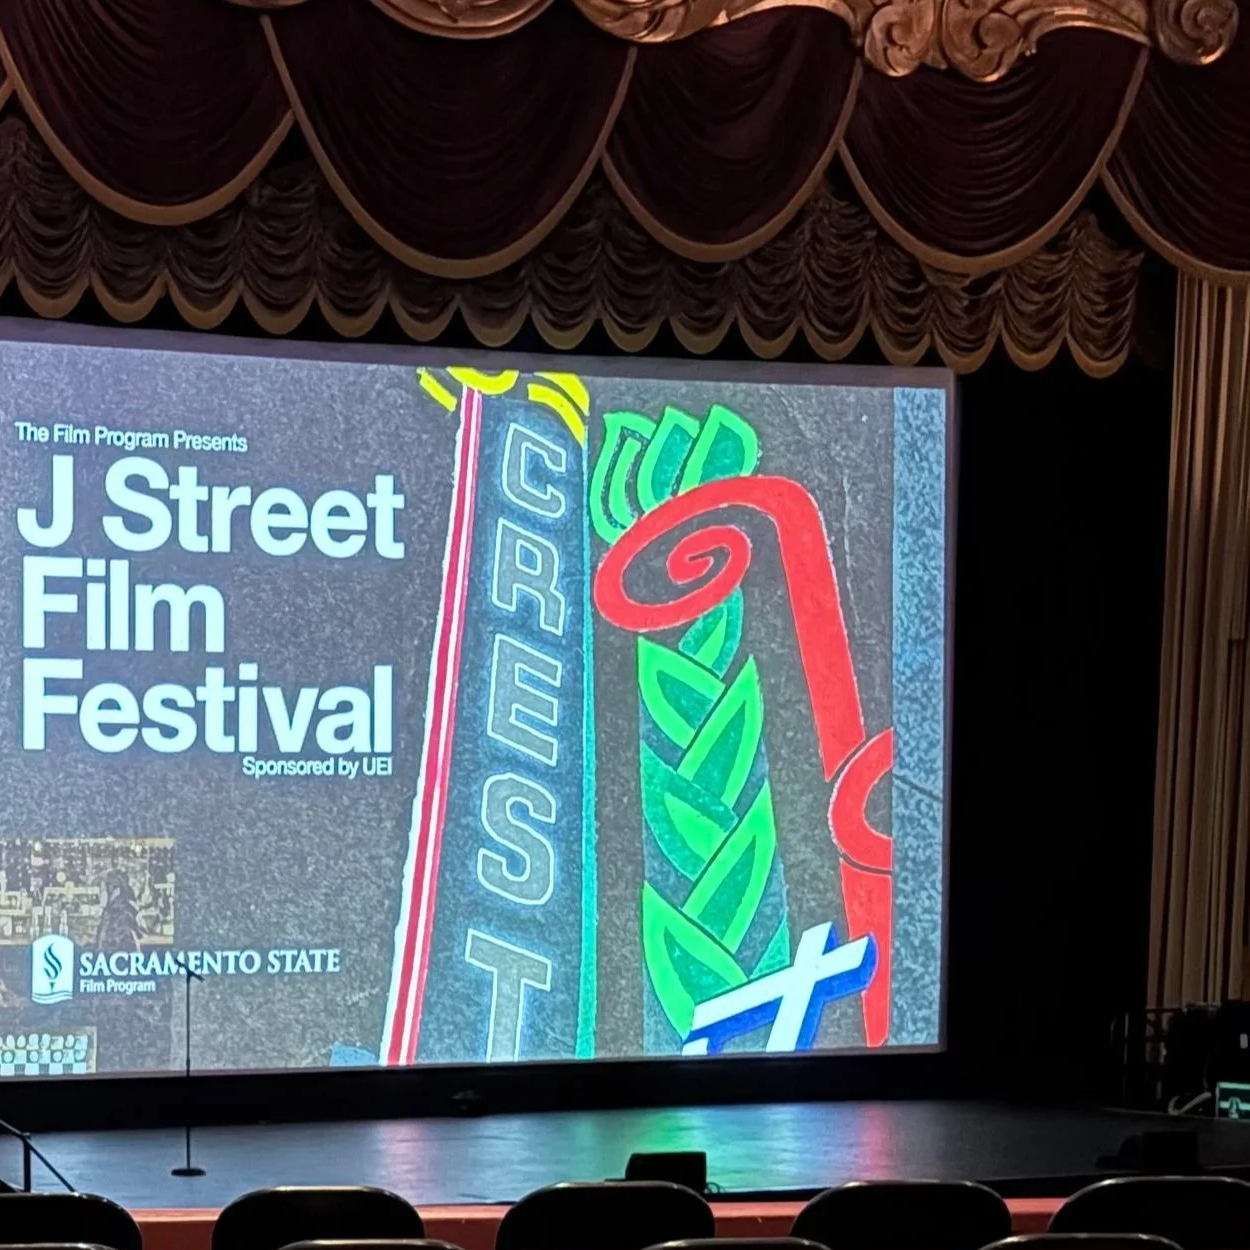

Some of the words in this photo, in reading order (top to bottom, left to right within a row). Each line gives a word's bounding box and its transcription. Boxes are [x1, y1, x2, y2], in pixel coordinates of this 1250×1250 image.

[15, 421, 50, 442] The
[53, 424, 91, 444] Film
[94, 426, 170, 450] Program
[173, 430, 248, 452] Presents
[17, 455, 74, 547] J
[102, 456, 406, 559] Street
[23, 555, 225, 653] Film
[23, 658, 393, 754] Festival
[242, 756, 335, 779] Sponsored
[338, 757, 359, 780] by
[362, 757, 393, 776] UEI
[79, 949, 262, 977] SACRAMENTO
[267, 948, 341, 974] STATE
[79, 979, 105, 993] Film
[106, 979, 156, 996] Program
